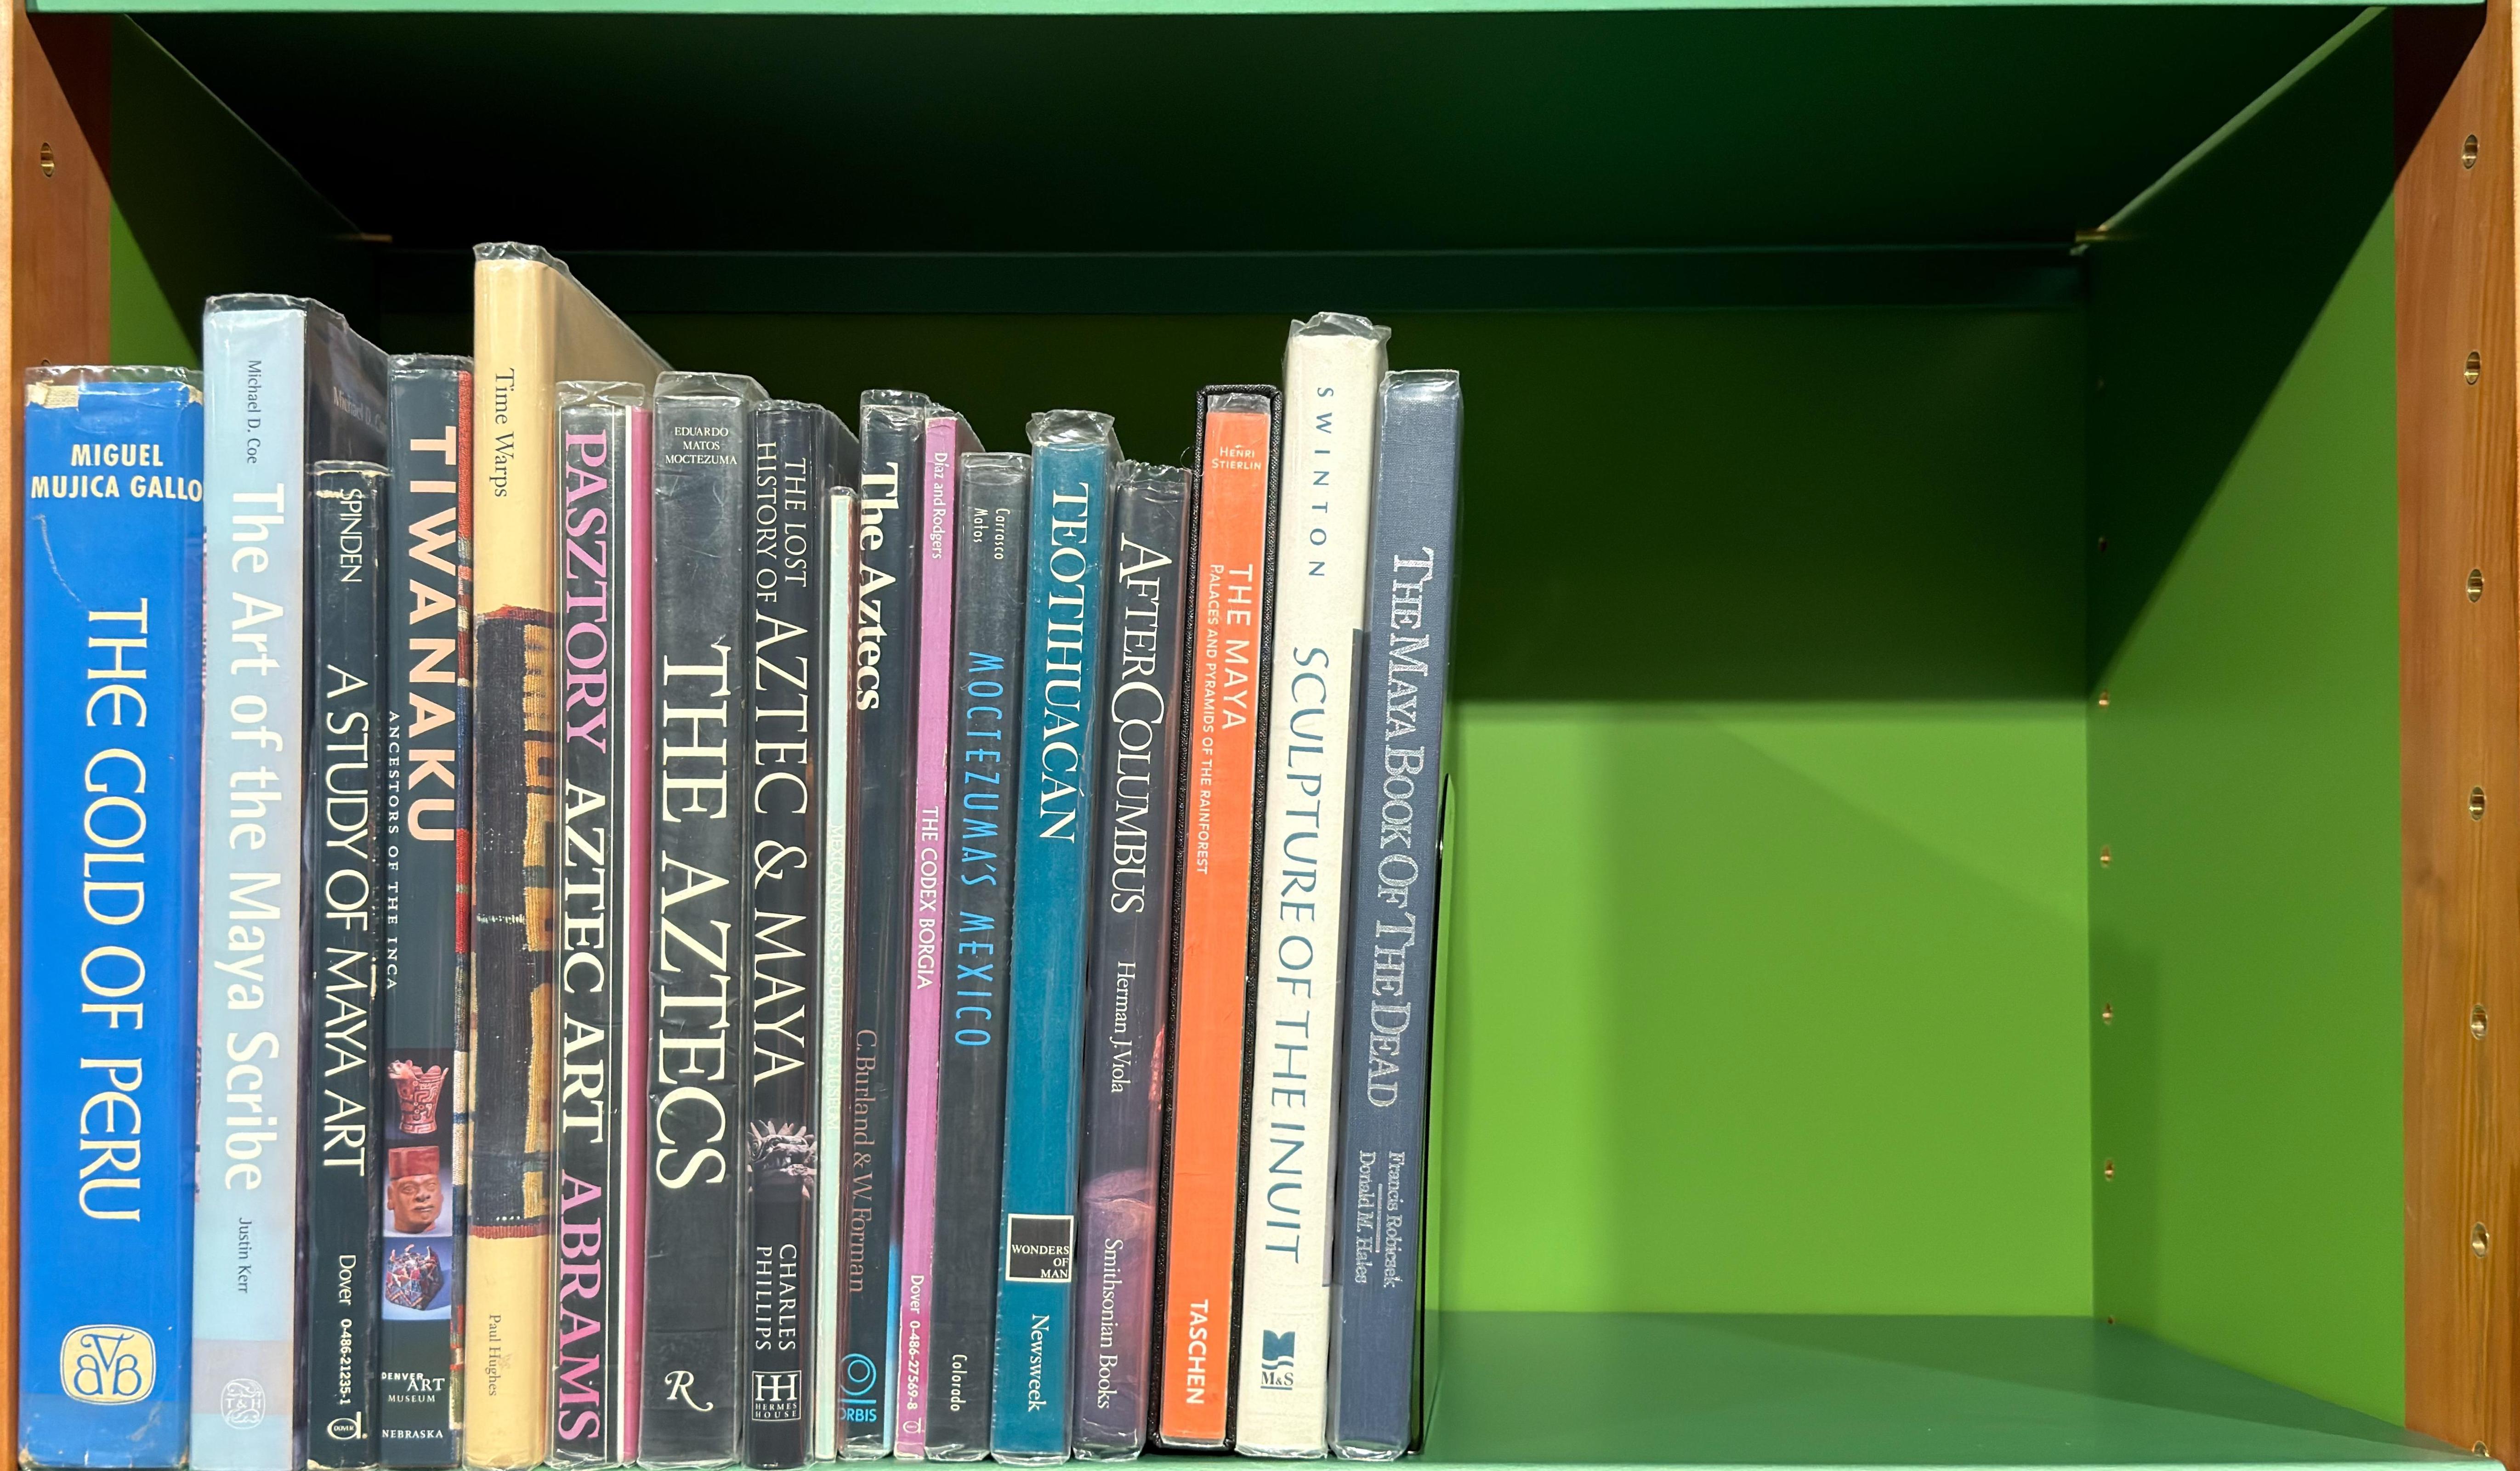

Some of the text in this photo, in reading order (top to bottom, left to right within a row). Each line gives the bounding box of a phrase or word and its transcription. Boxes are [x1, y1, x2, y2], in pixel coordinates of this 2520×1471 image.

[71, 444, 163, 467] MIGUEL
[246, 360, 262, 464] Michael D. Coe
[490, 368, 515, 497] Time Warps
[665, 455, 737, 464] MOCTEZUMA
[675, 427, 729, 436] EDUARDO
[683, 441, 720, 450] MATOS
[1220, 446, 1255, 458] HENRI
[31, 475, 203, 502] MUJICA GALLO
[931, 453, 948, 560] Díaz and Rodgers
[1211, 458, 1261, 470] STIERLIN
[1308, 387, 1334, 577] SWINTON
[339, 488, 363, 582] SPINDEN
[756, 441, 777, 603] HISTORY OF
[784, 458, 807, 587] THE LOST
[973, 508, 988, 543] Matos
[994, 508, 1010, 560] Carrasco
[408, 425, 457, 841] TIWANAKU
[857, 462, 899, 710] The Aztecs
[1039, 482, 1089, 843] TEOTIHUACÁN
[1222, 564, 1253, 730] THE MAYA
[1196, 565, 1224, 875] PALACES AND PYRAMIDS OF THE RAINFOREST
[214, 483, 284, 1190] The Art of the Maya Scribe
[562, 429, 607, 1143] PASZTORY AZTEC ART
[1368, 546, 1434, 1107] THE MAYA BOOK OF THE DEAD
[387, 711, 400, 989] ANCESTORS OF THE INCA
[754, 609, 808, 1087] AZTEC & MAYA
[917, 806, 938, 989] THE CODEX BORGIA
[955, 652, 1004, 1046] MOCTEZUMA'S MEXICO
[79, 598, 148, 1222] THE GOLD OF PERU
[323, 665, 369, 1176] A STUDY OF MAYA ART
[656, 645, 731, 1189] THE AZTECS
[1265, 647, 1329, 1264] SCULPTURE OF THE INUIT
[856, 1029, 877, 1051] C.
[1109, 961, 1136, 1092] Herman J. Viola
[852, 1058, 876, 1152] Burland
[853, 1152, 872, 1168] &
[1358, 1150, 1376, 1208] Donald
[237, 1216, 252, 1294] Justin Kerr
[849, 1206, 872, 1293] Forman
[1012, 1245, 1069, 1254] WONDERS
[1053, 1258, 1069, 1267] OF
[1355, 1236, 1373, 1283] Hales
[1384, 1151, 1405, 1287] Francis Robicsek
[339, 1255, 356, 1305] Dover
[558, 1170, 601, 1440] ABRAMS
[755, 1246, 772, 1350] PHILLIPS
[779, 1244, 797, 1351] CHARLES
[910, 1275, 924, 1314] Dover
[1041, 1269, 1068, 1279] MAN
[1098, 1239, 1123, 1409] Smithsonian Books
[406, 1378, 445, 1392] ART
[485, 1314, 501, 1397] Paul Hughes
[907, 1321, 920, 1410] 0-486-27569-8
[950, 1354, 967, 1411] Colorado
[1028, 1314, 1050, 1412] Newsweek
[1186, 1299, 1209, 1405] TASCHEN
[1261, 1371, 1294, 1386] M&S
[382, 1430, 443, 1439] NEBRASKA
